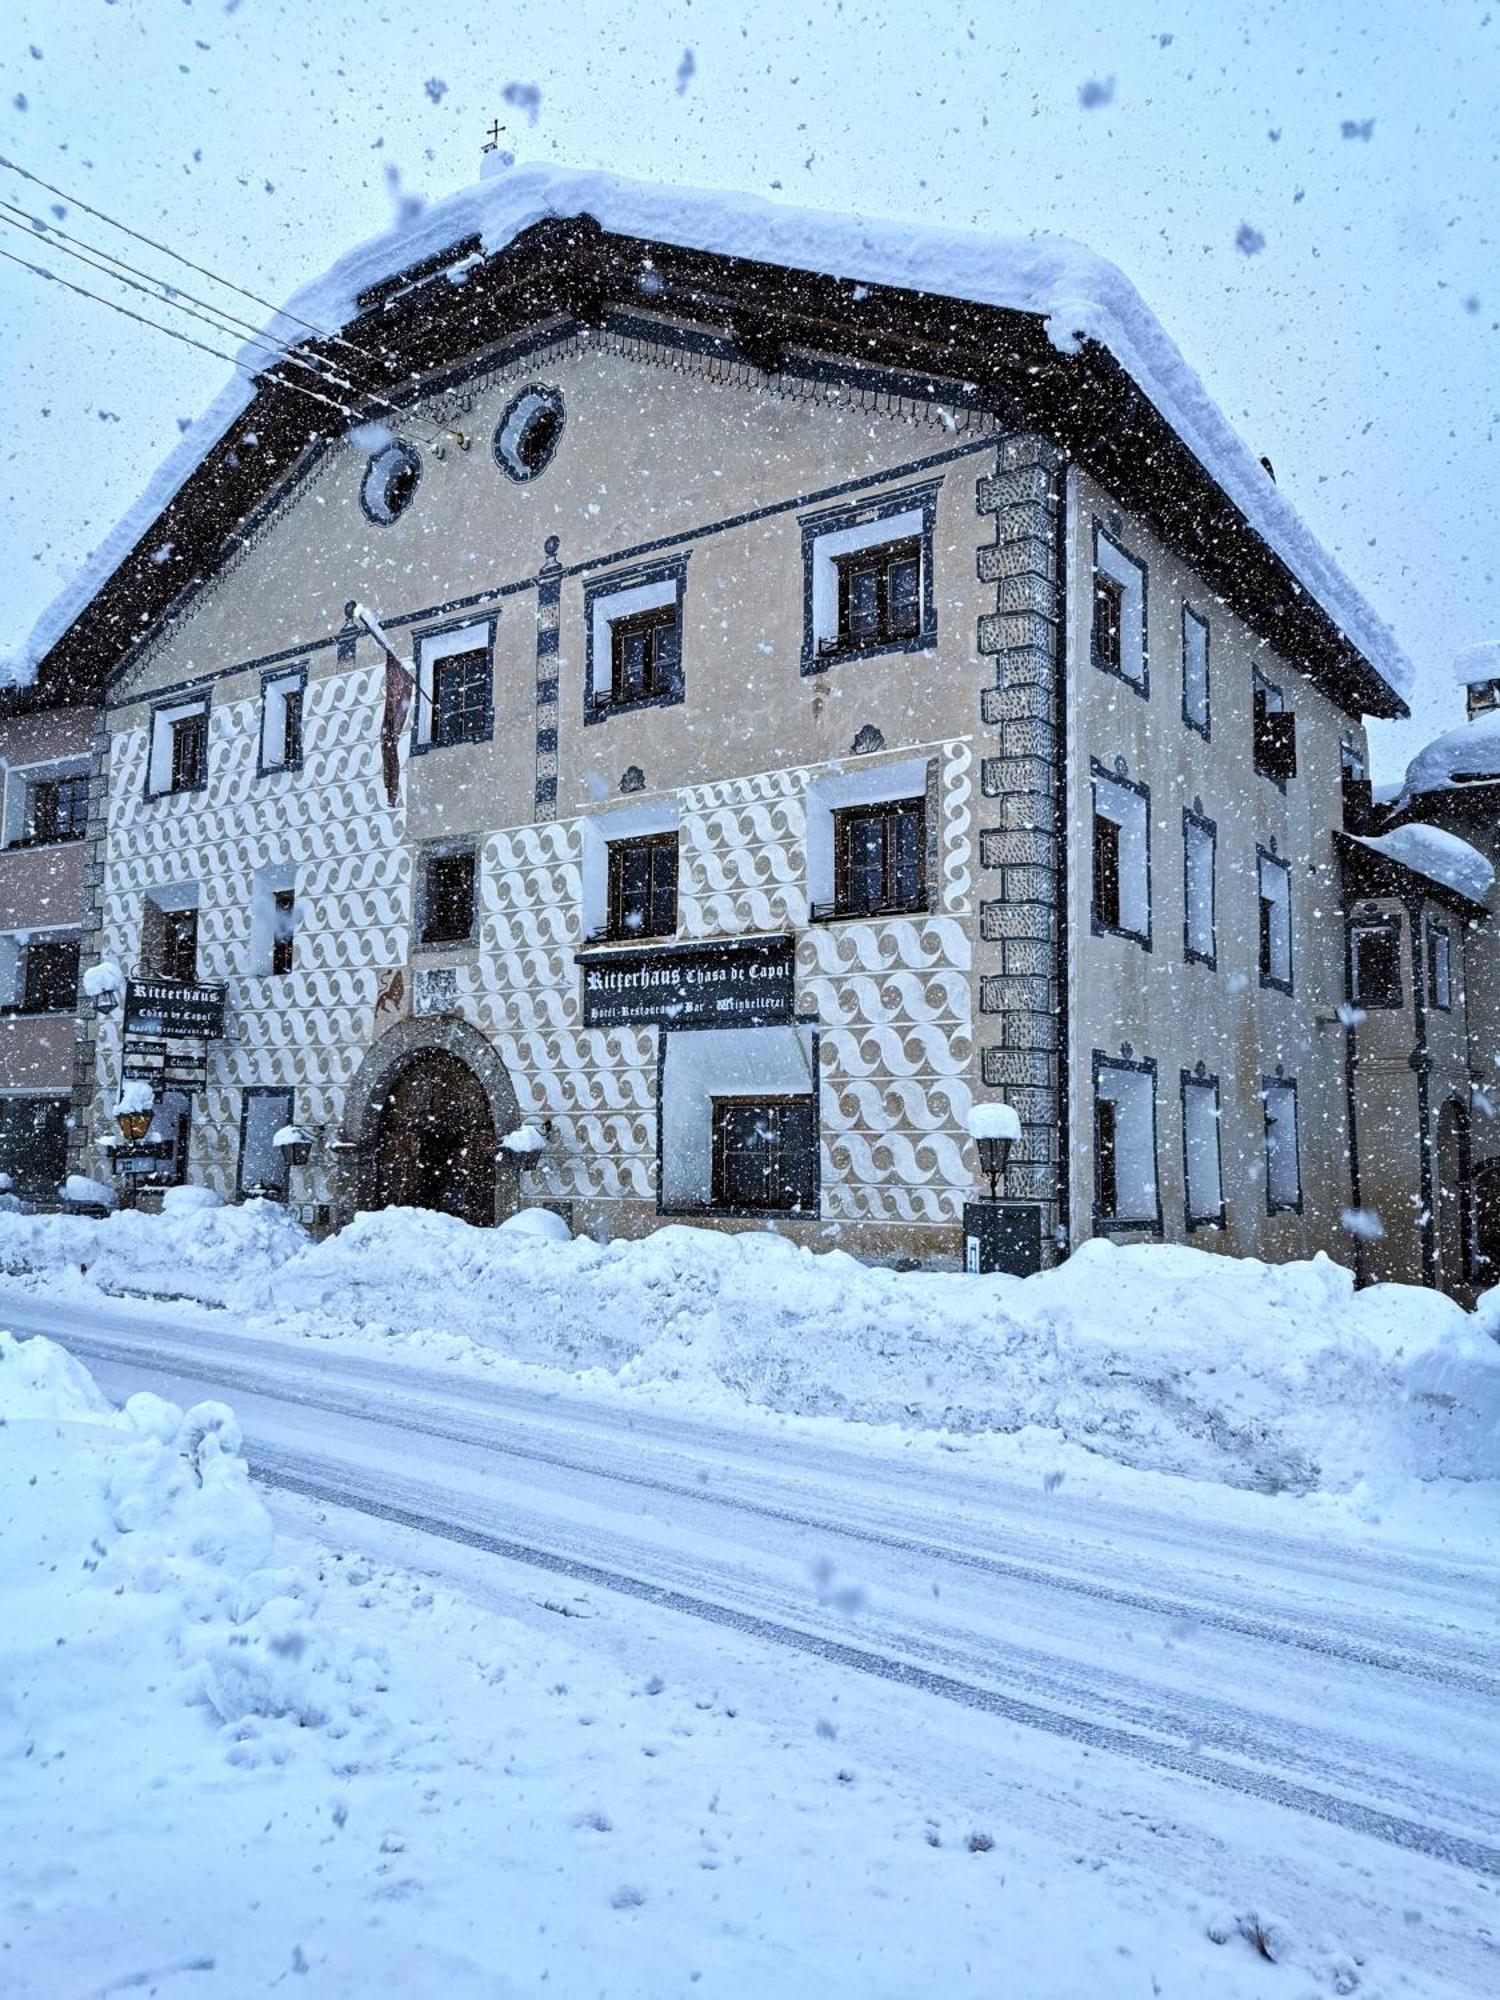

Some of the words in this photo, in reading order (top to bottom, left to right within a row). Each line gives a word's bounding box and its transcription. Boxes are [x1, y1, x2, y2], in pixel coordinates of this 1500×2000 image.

[587, 964, 680, 992] Ritterhaus
[686, 968, 726, 985] Chasa
[731, 967, 745, 981] de
[749, 962, 790, 979] Capol
[133, 984, 219, 1002] Ritterhaus
